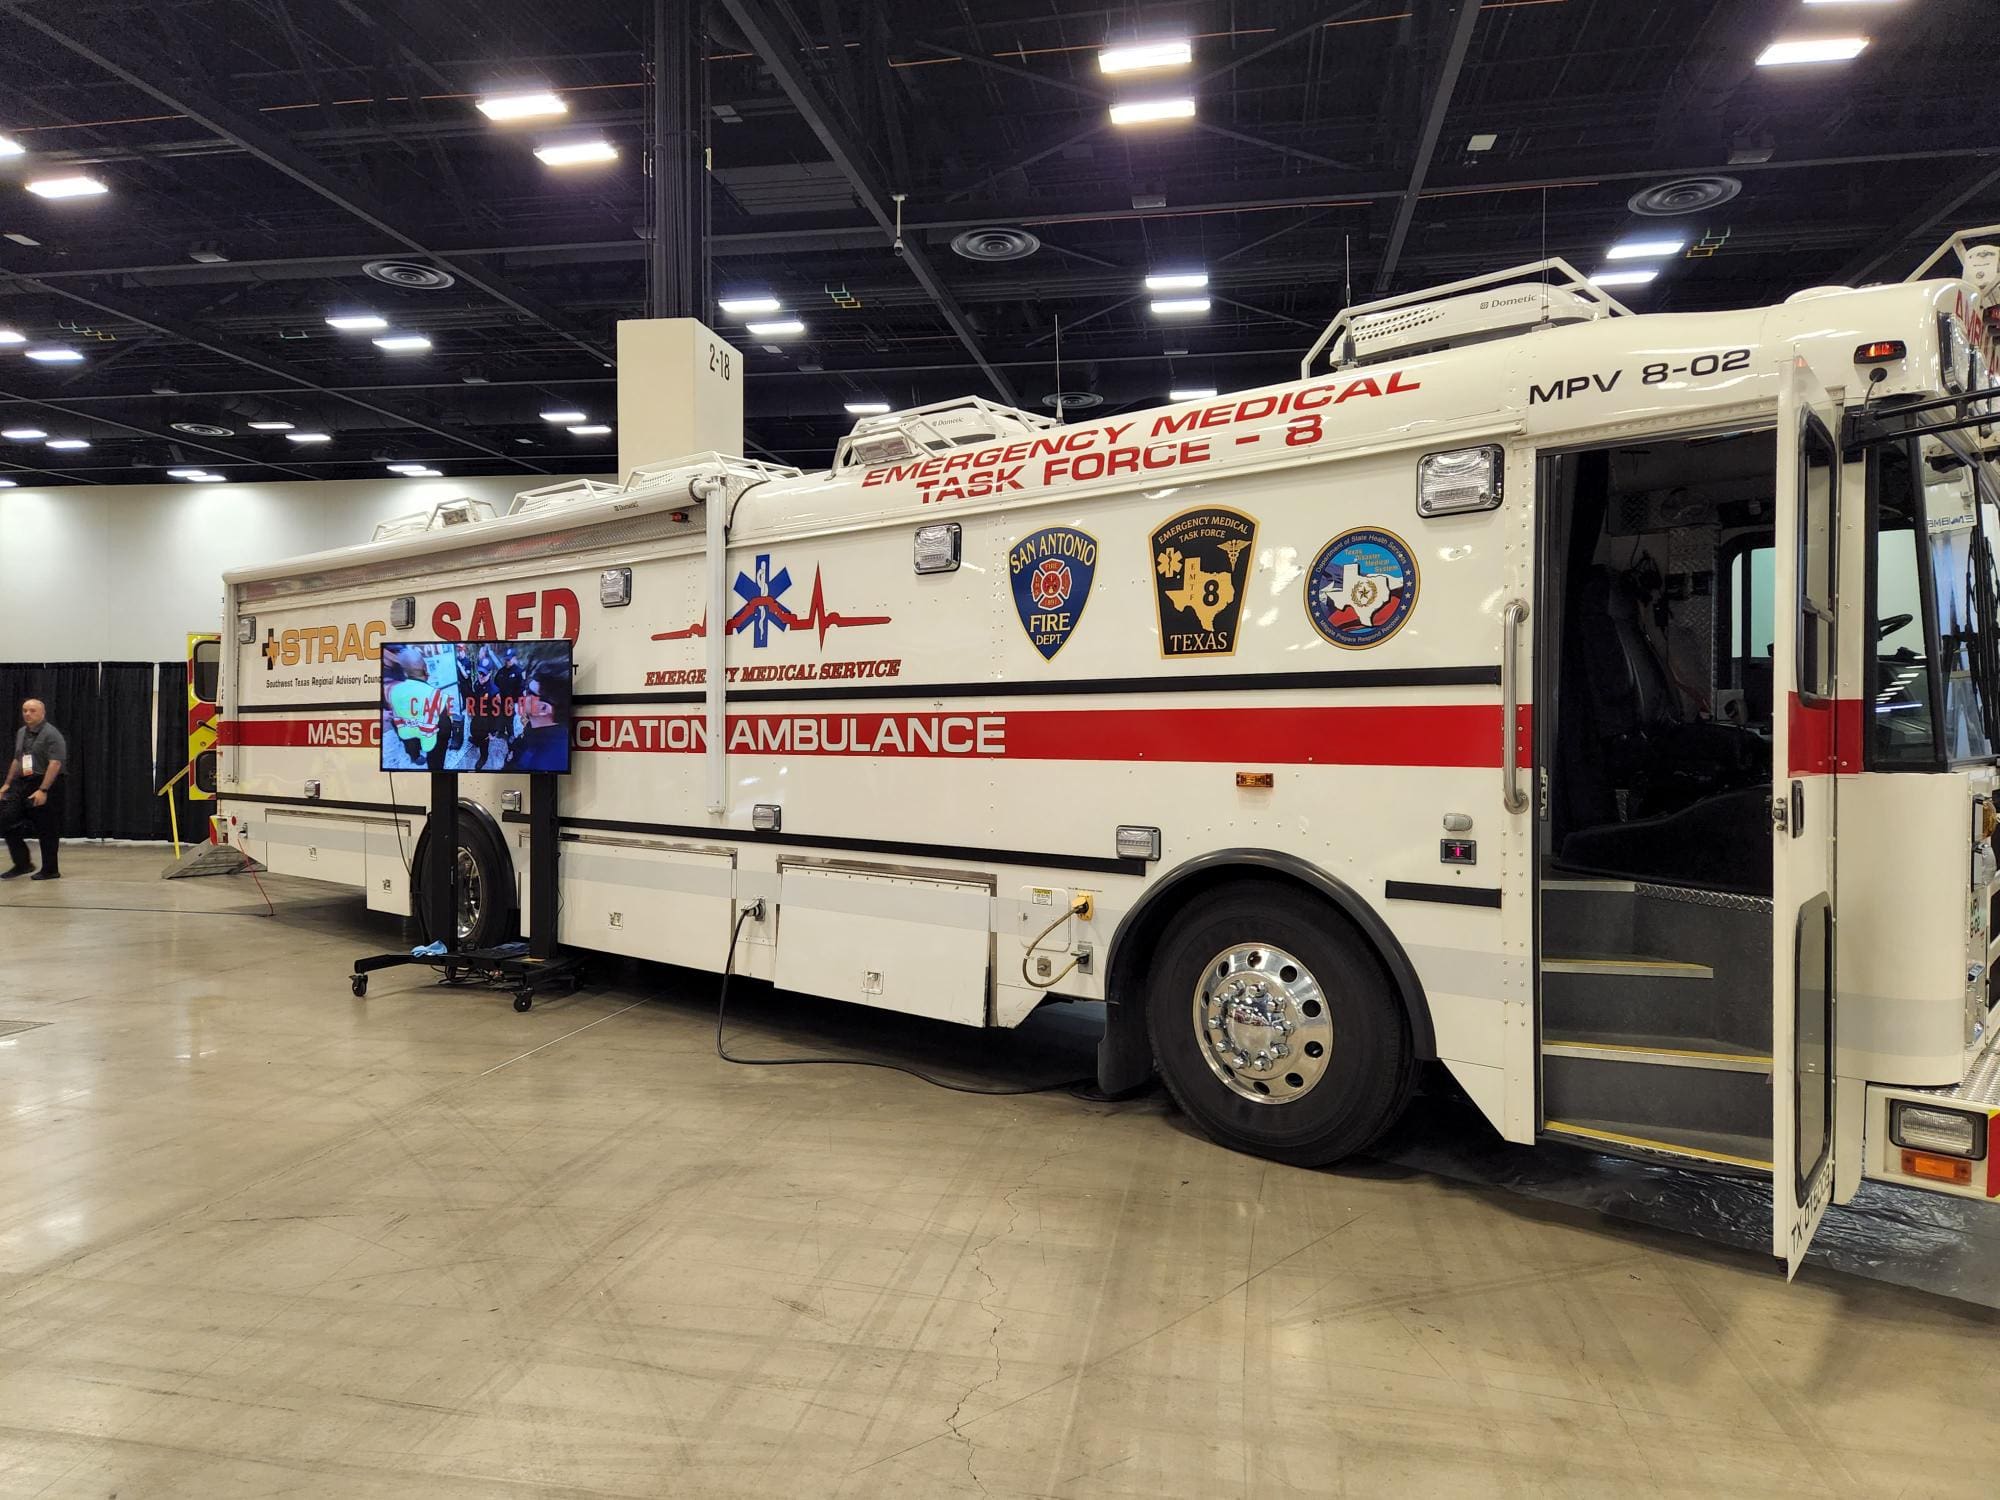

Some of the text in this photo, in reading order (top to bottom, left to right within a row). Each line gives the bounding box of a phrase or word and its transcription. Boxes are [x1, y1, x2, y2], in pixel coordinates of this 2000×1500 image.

[1491, 294, 1537, 308] Dometic
[708, 343, 731, 382] 2-18
[1529, 348, 1751, 405] MPV 8-02
[862, 371, 1422, 488] EMERGENCY MEDICAL
[917, 463, 1026, 504] TASK
[1042, 435, 1211, 486] FORCE
[1285, 413, 1325, 447] 8
[1158, 516, 1249, 544] EMERGENCY MEDICAL
[1178, 528, 1227, 543] TASK FORCE
[1010, 532, 1096, 574] SAN ANTONIO
[1202, 579, 1220, 607] 8
[432, 588, 580, 648] SAFD
[1030, 612, 1071, 633] FIRE
[281, 620, 387, 667] STRAC
[1036, 633, 1063, 646] DEPT.
[1169, 631, 1228, 652] TEXAS
[266, 673, 381, 689] Southwest Texas Regional Advisory Counc
[644, 659, 902, 687] EMERGEY MEDICAL SERVICE
[409, 695, 541, 718] CAVE RESCUE
[307, 722, 363, 745] MASS
[572, 718, 707, 749] CUATION
[729, 716, 1006, 754] AMBULANCE
[1790, 1220, 1803, 1255] TX
